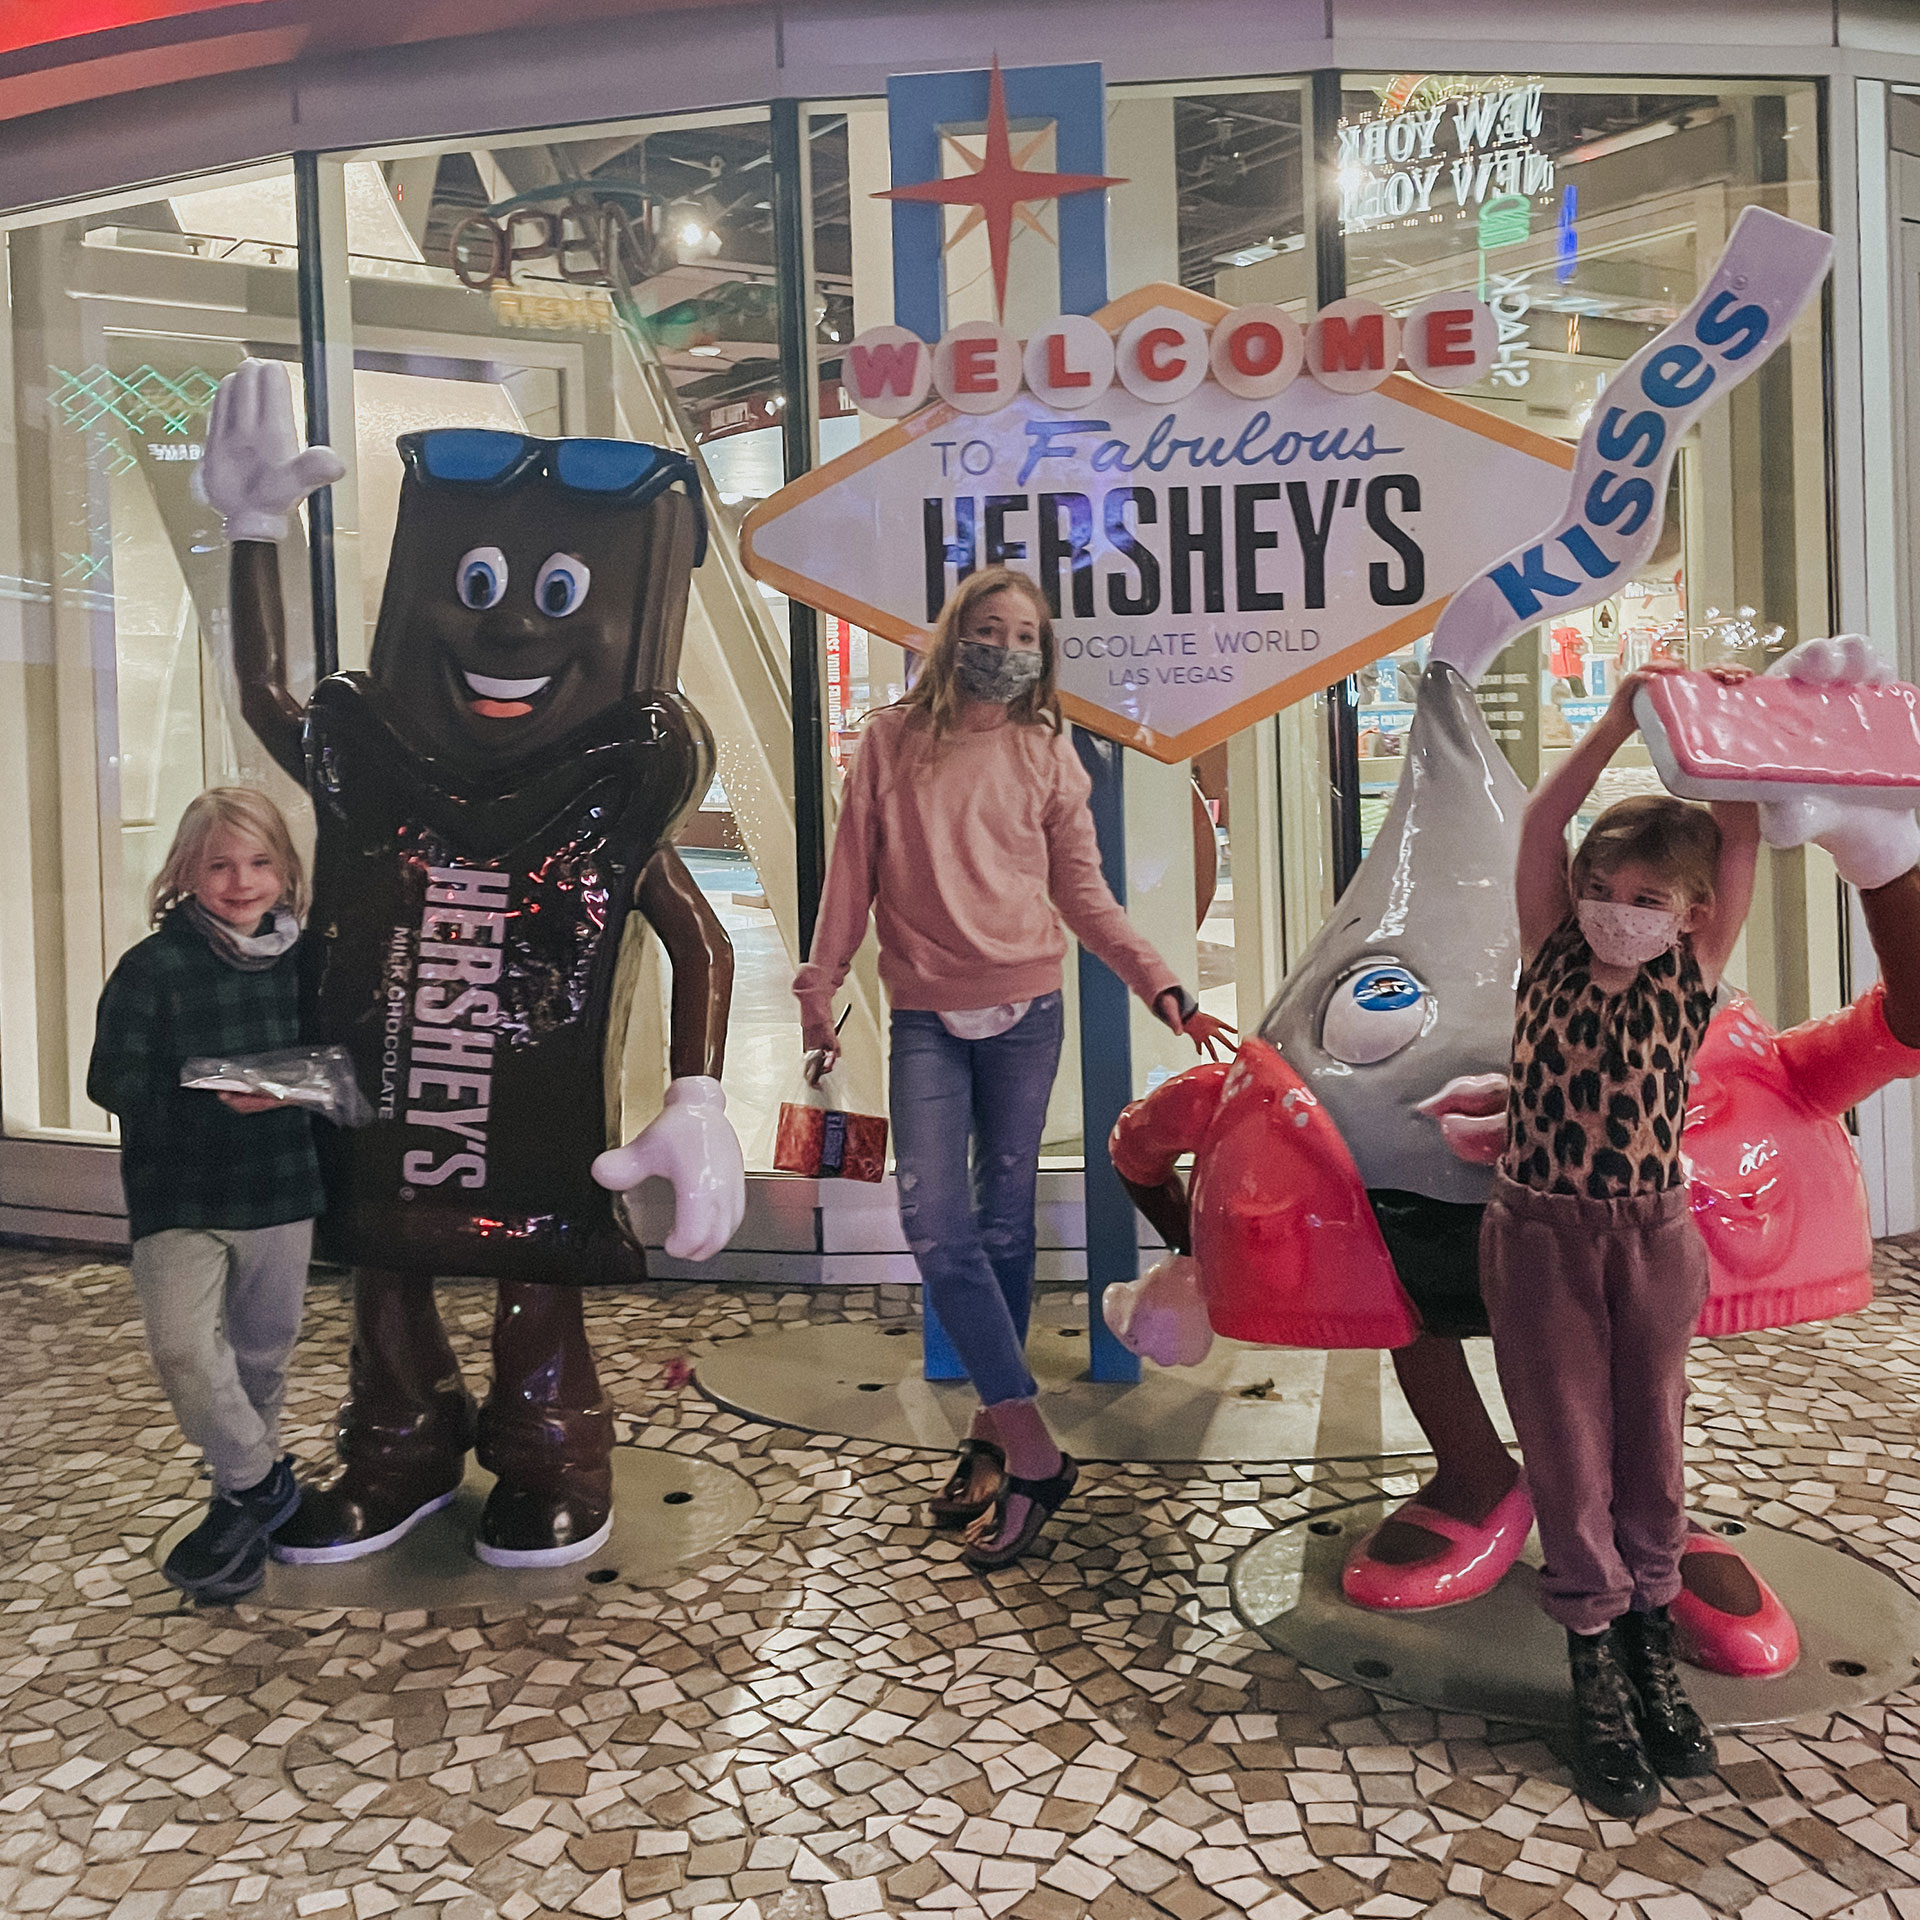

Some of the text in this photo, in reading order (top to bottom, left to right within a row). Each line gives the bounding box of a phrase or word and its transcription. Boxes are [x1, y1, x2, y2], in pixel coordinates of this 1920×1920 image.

[848, 308, 1476, 400] WELCOME
[931, 411, 1404, 487] TO Fabulous
[924, 474, 1425, 624] HERSHEY'S
[1108, 665, 1234, 687] LAS VEGAS
[1214, 629, 1320, 654] WORLD
[378, 926, 411, 1121] MILK CHOCOLATE
[403, 867, 510, 1189] HERSHEY'S
